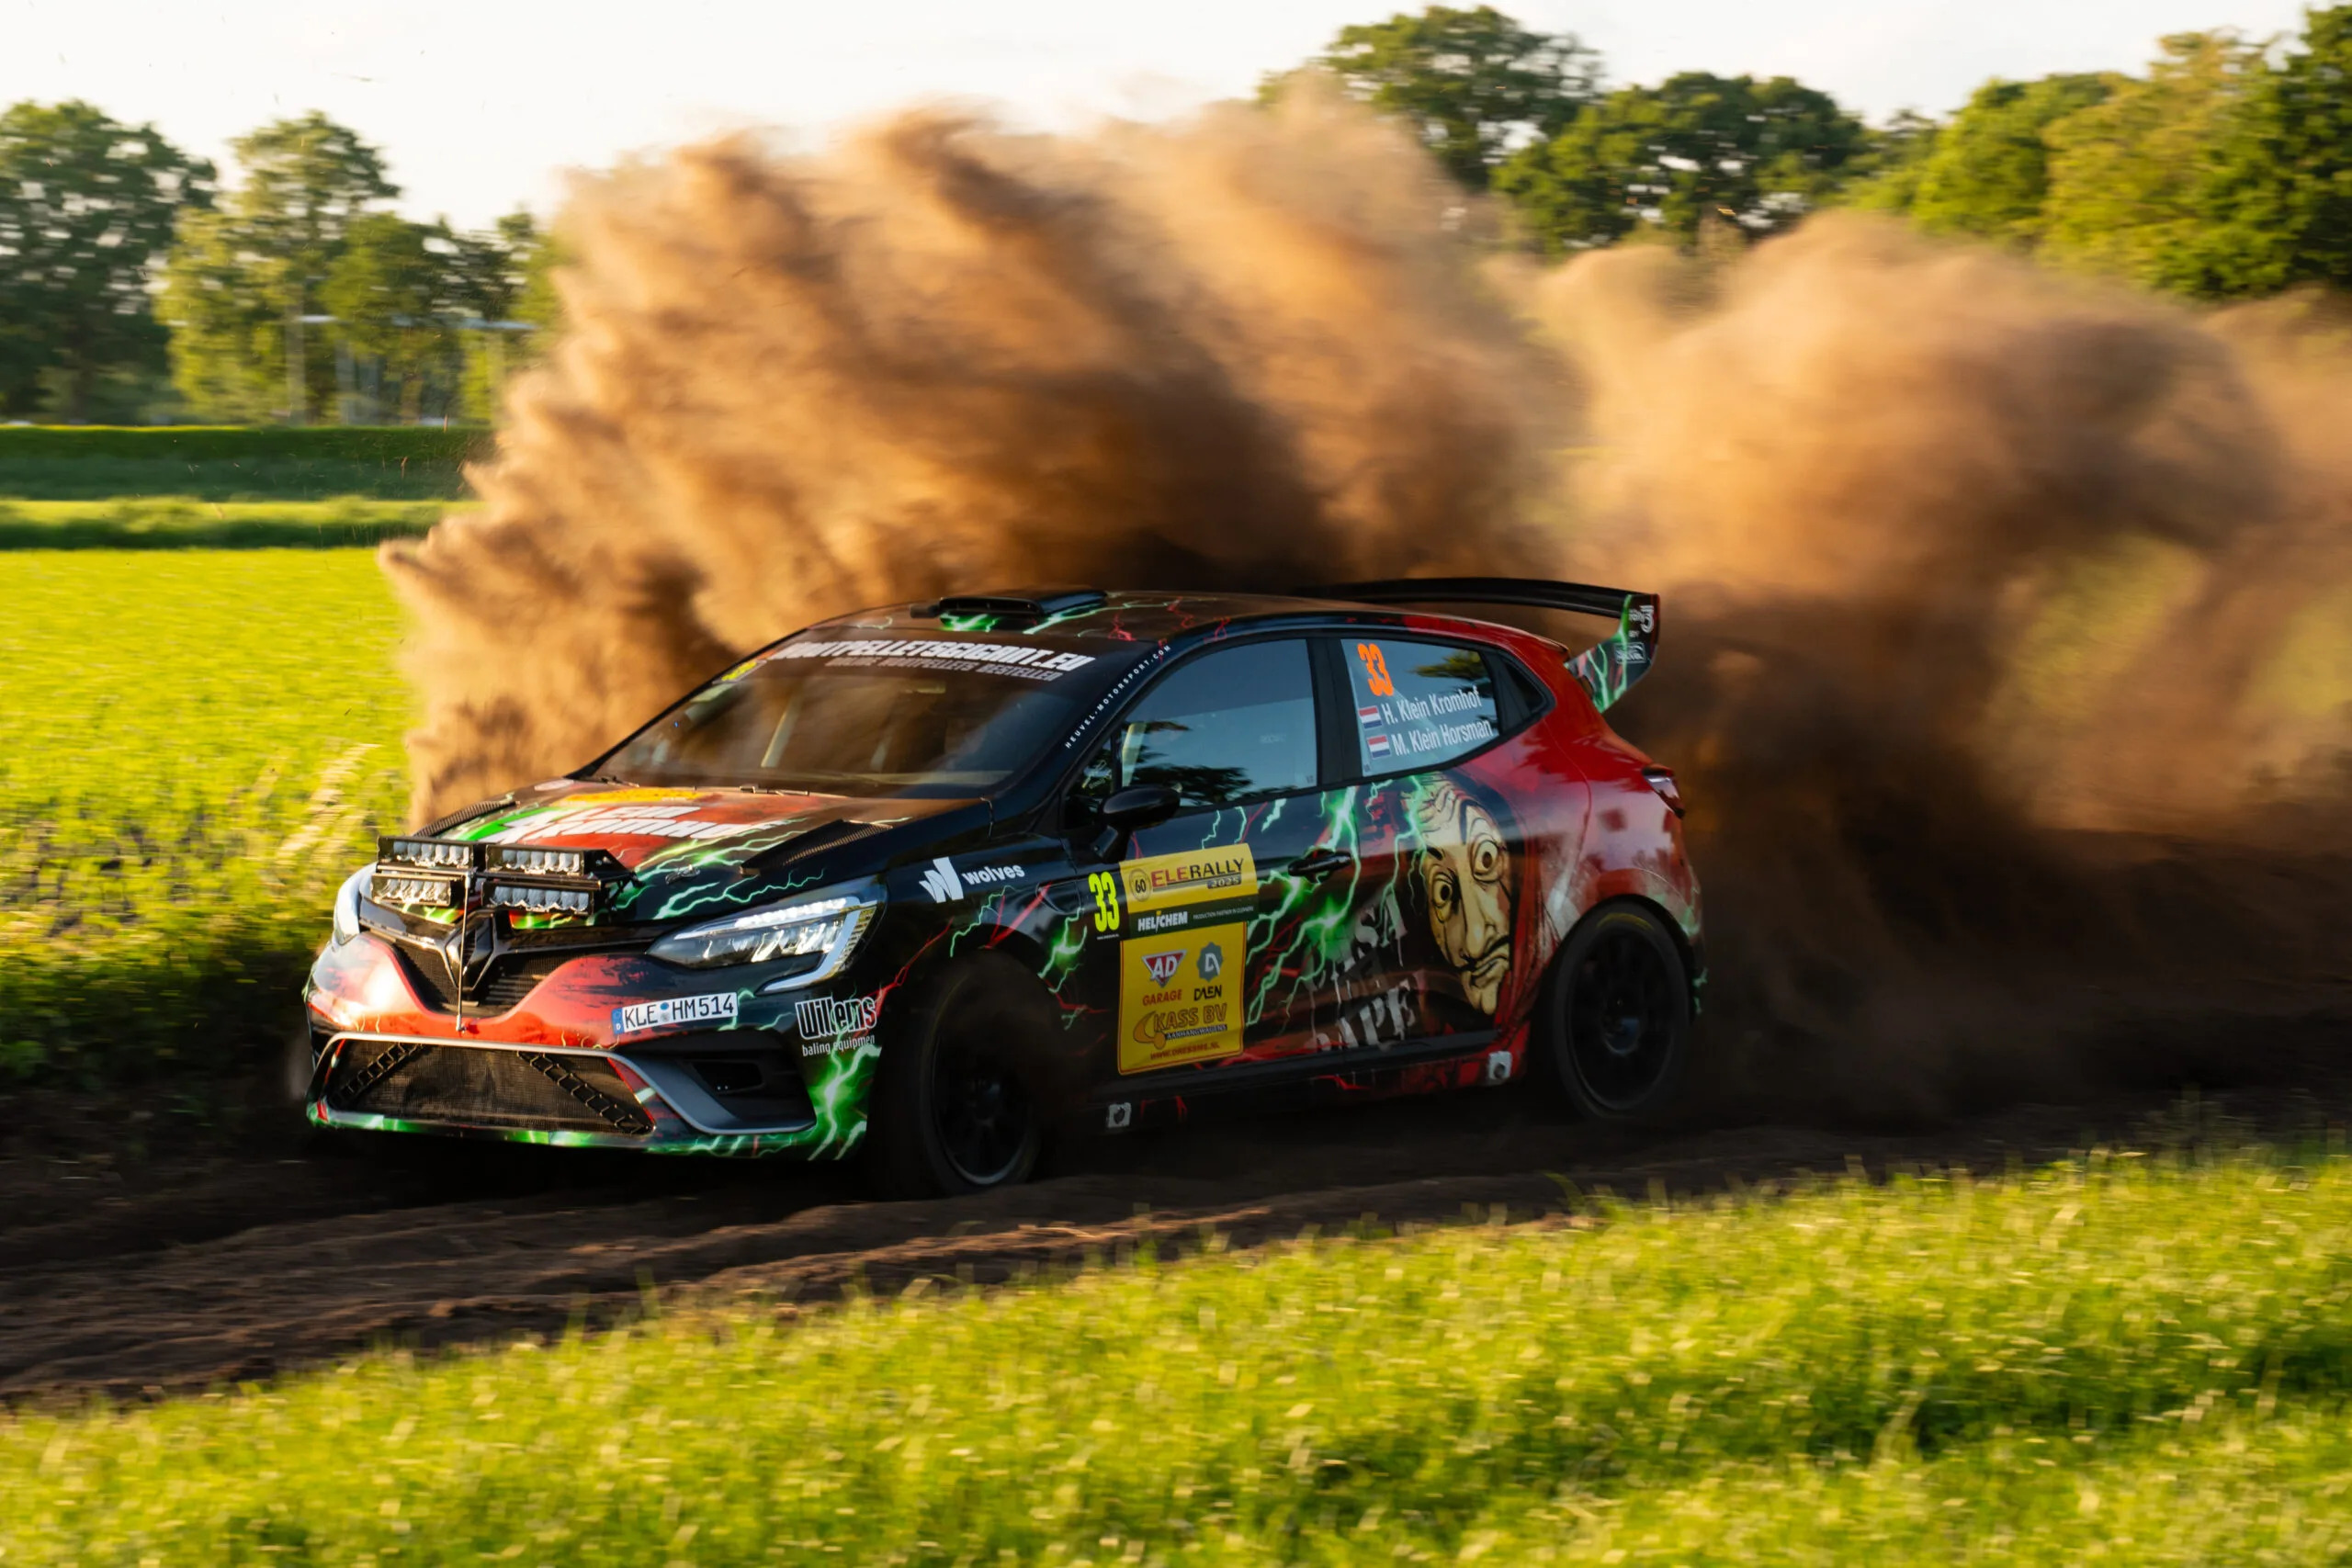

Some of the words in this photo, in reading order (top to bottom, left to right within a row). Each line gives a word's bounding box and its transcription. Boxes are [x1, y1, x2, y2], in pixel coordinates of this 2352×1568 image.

[767, 640, 1096, 671] TPELLETSGIGANT.EU
[1357, 643, 1394, 696] 33
[1381, 702, 1398, 726] H.
[1396, 697, 1431, 722] Klein
[1429, 685, 1482, 716] Kromhof
[1391, 733, 1410, 756] M.
[1408, 728, 1441, 752] Klein
[1439, 719, 1494, 747] Horsman
[478, 817, 788, 844] KROMHO
[962, 864, 1025, 886] wolves
[1135, 879, 1147, 894] 60
[1210, 876, 1240, 889] 2025
[1088, 872, 1120, 932] 33
[1149, 955, 1177, 981] AD
[1142, 989, 1182, 1007] GARAGE
[1193, 985, 1223, 1002] DAEN
[624, 1004, 658, 1029] KLE
[795, 997, 877, 1041] Willems
[1153, 1008, 1199, 1032] KASS
[1203, 1003, 1227, 1024] BV
[802, 1043, 831, 1057] baling
